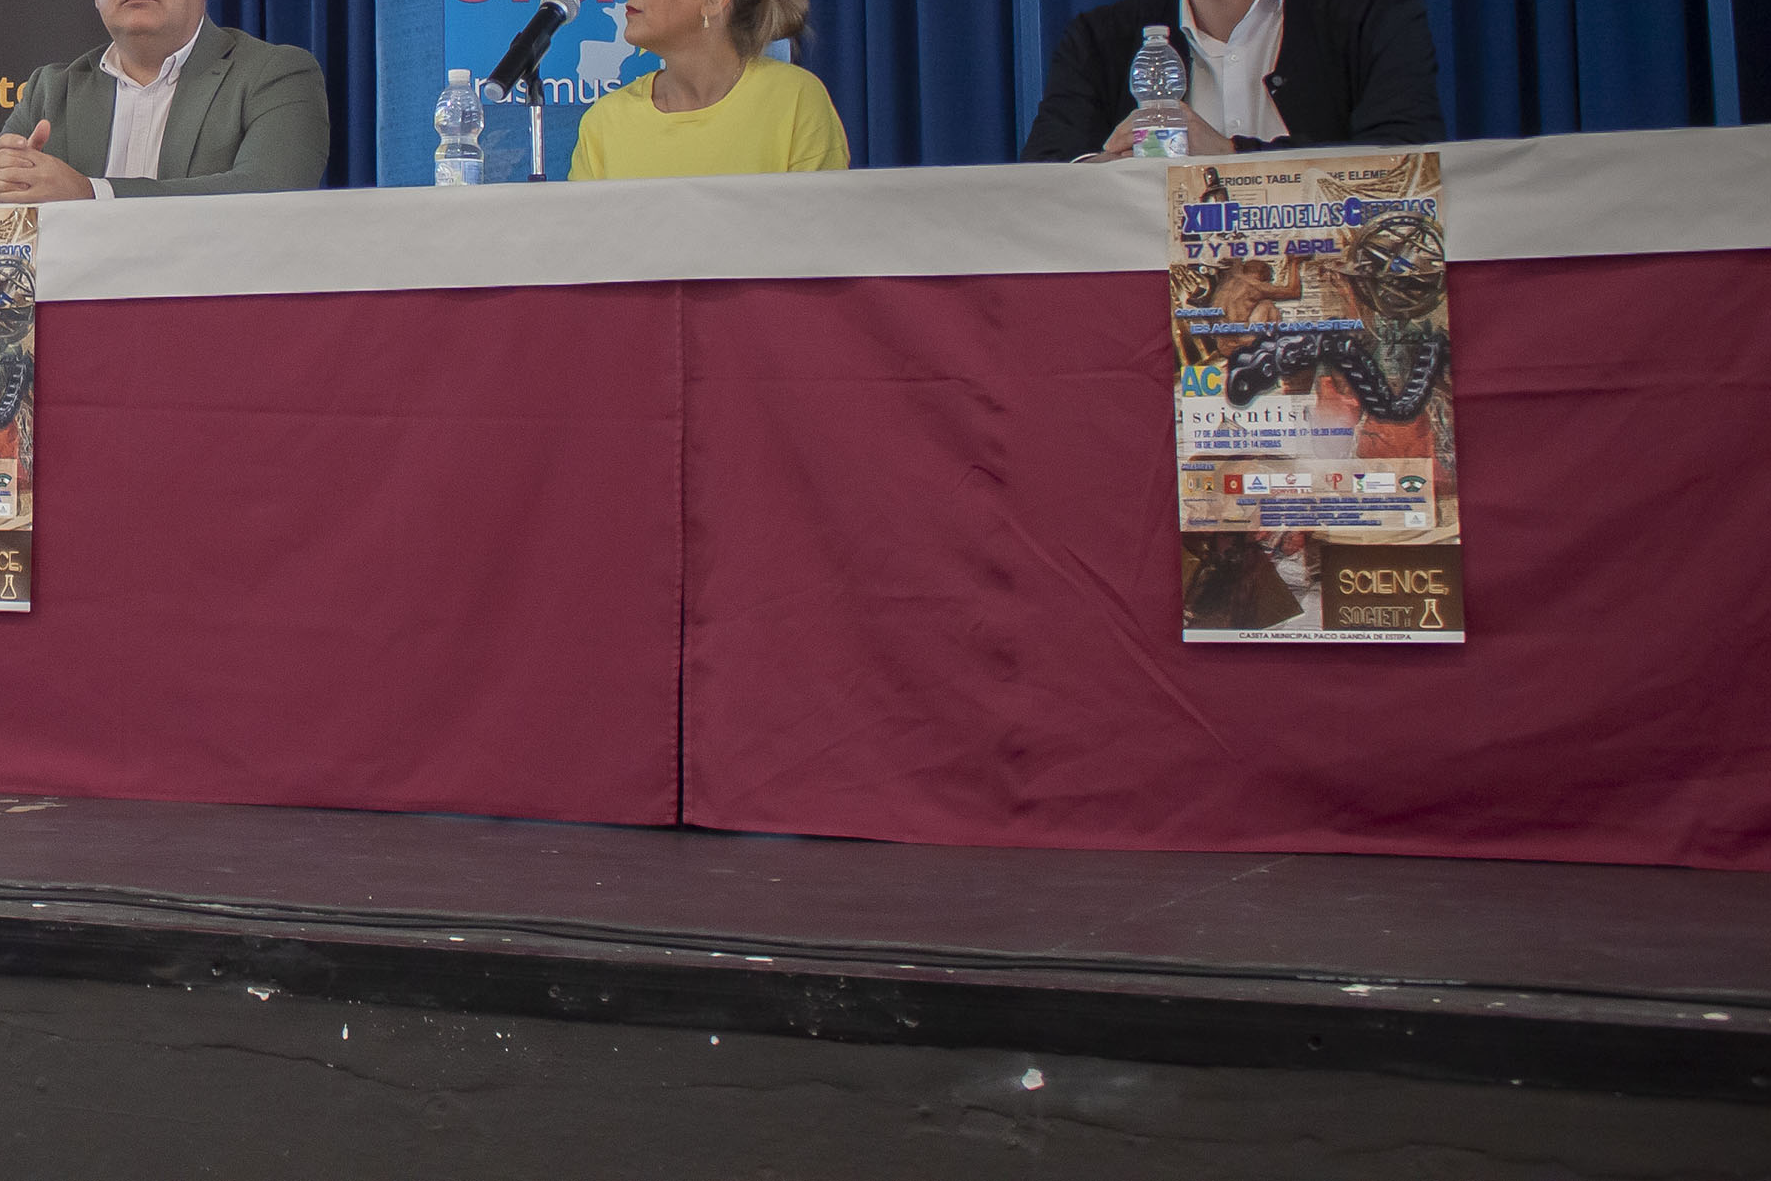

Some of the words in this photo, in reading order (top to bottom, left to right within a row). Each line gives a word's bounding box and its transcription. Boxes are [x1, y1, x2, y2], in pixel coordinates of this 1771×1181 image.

[1218, 175, 1263, 187] ERIODIC
[1266, 173, 1302, 185] TABLE
[1184, 243, 1204, 259] 17
[1208, 242, 1223, 258] Y
[1227, 241, 1249, 258] 18
[1253, 240, 1280, 256] DE
[1284, 238, 1342, 256] ABRIL
[1181, 365, 1222, 397] AC
[1192, 406, 1310, 424] scientist
[1338, 605, 1414, 628] SOCIETY
[1271, 632, 1312, 640] MUNICIPAL
